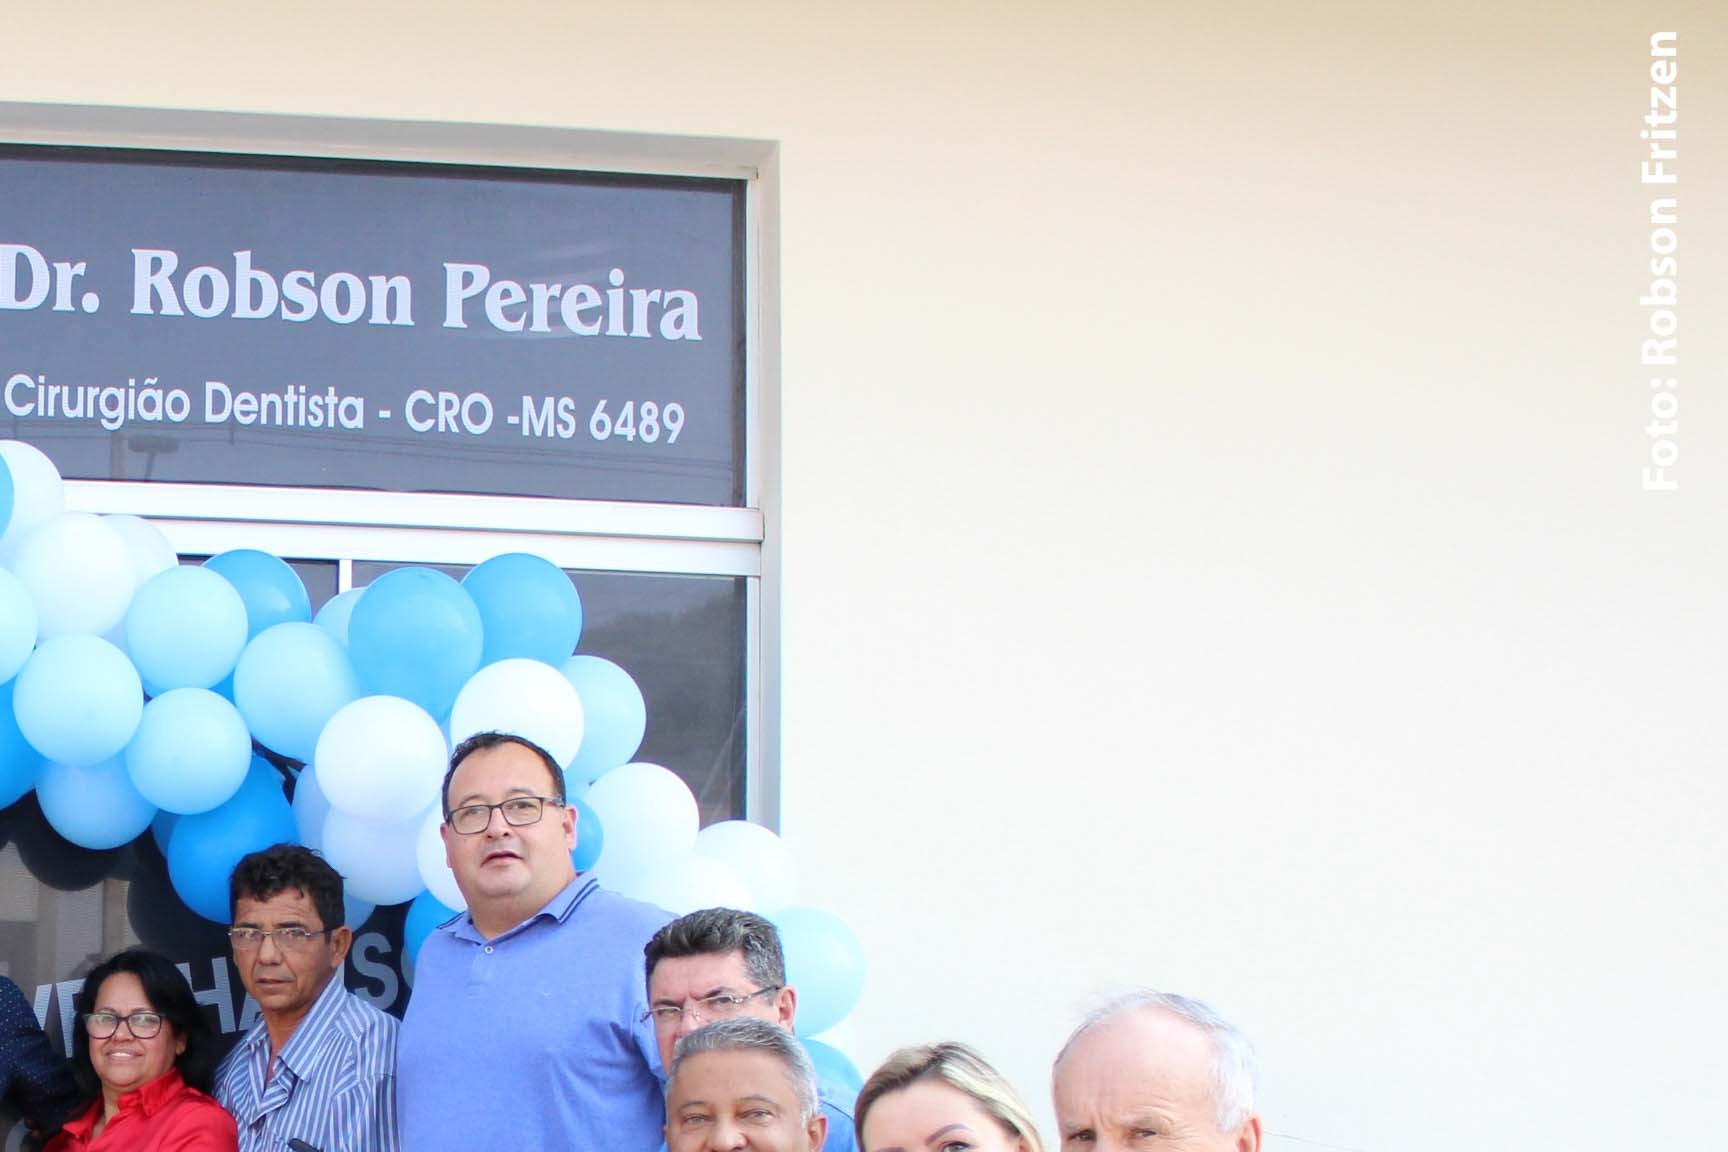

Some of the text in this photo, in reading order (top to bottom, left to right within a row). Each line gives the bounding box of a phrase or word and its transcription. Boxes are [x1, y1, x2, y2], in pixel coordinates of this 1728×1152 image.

[130, 248, 415, 327] Robson
[442, 262, 703, 341] Pereira
[4, 373, 191, 431] Cirurgião
[204, 381, 365, 429] Dentista
[405, 389, 494, 436] CRO
[589, 399, 686, 445] 6489
